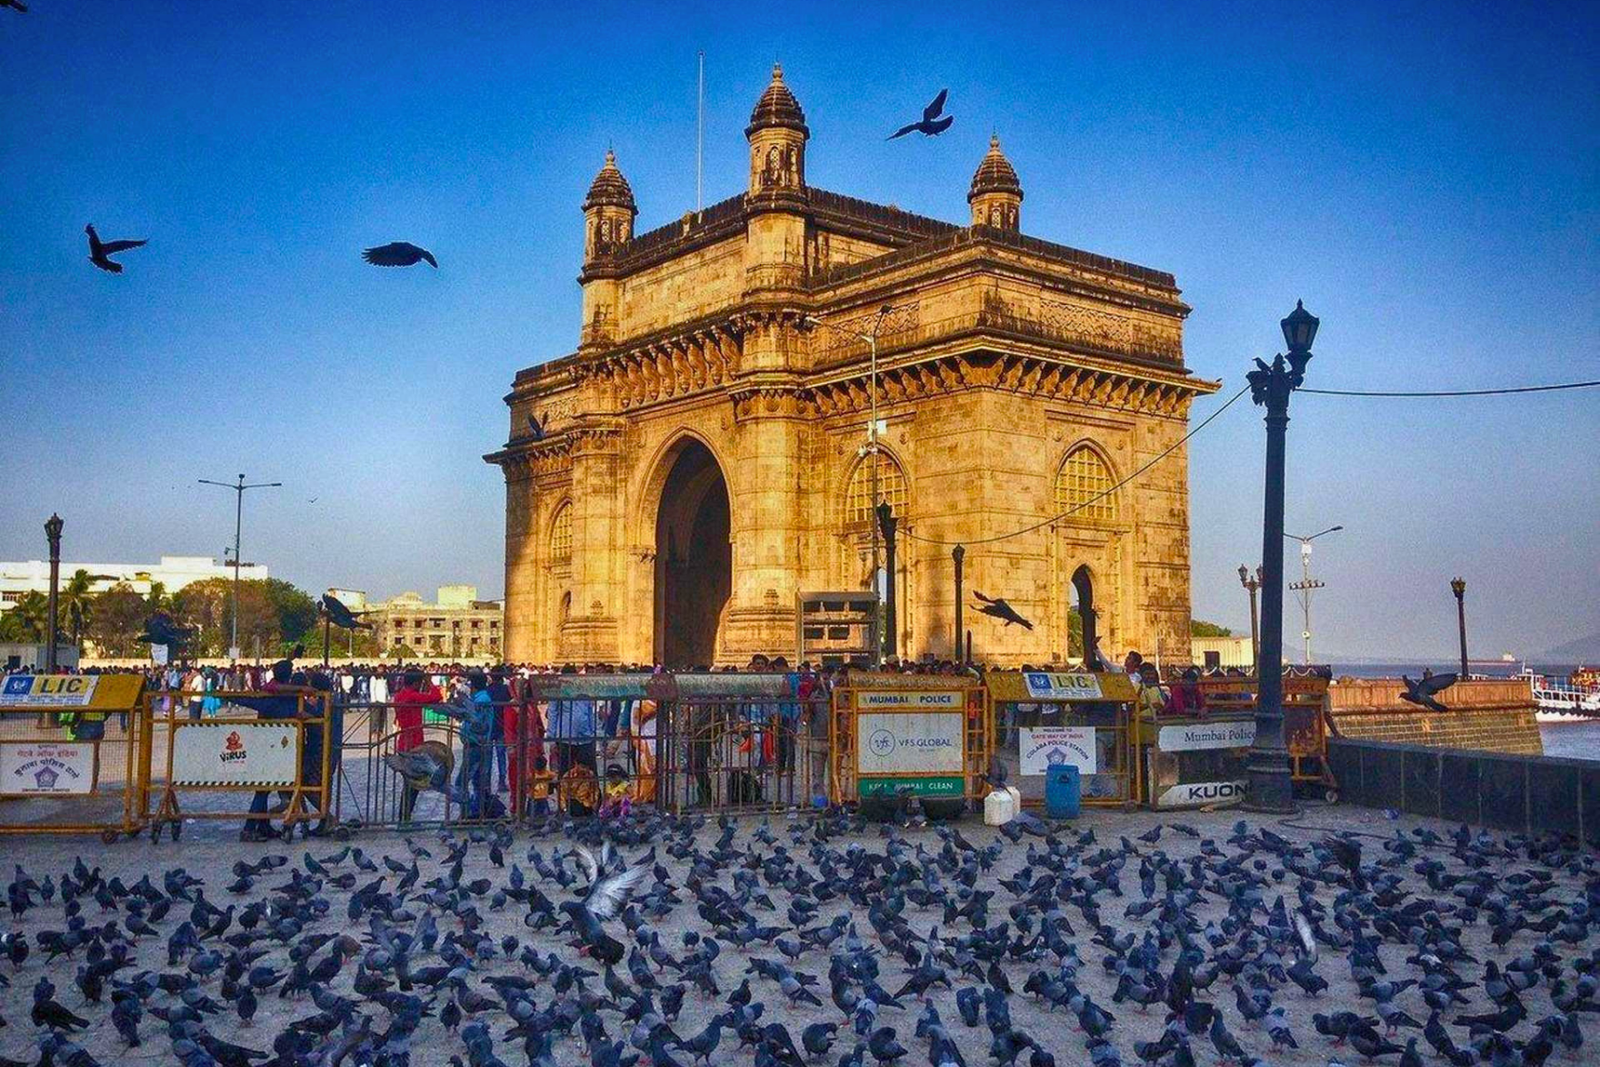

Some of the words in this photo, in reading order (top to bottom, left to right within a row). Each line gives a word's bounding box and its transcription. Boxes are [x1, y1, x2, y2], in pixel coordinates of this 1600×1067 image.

[40, 678, 82, 693] LIC
[1056, 676, 1087, 688] LIC
[869, 695, 909, 704] MUMBAI
[920, 695, 952, 703] POLICE
[1185, 730, 1226, 742] Mumbai
[916, 738, 953, 747] GLOBAL
[1026, 742, 1047, 759] COLABA
[1069, 742, 1089, 760] STATION
[928, 782, 954, 790] CLEAN
